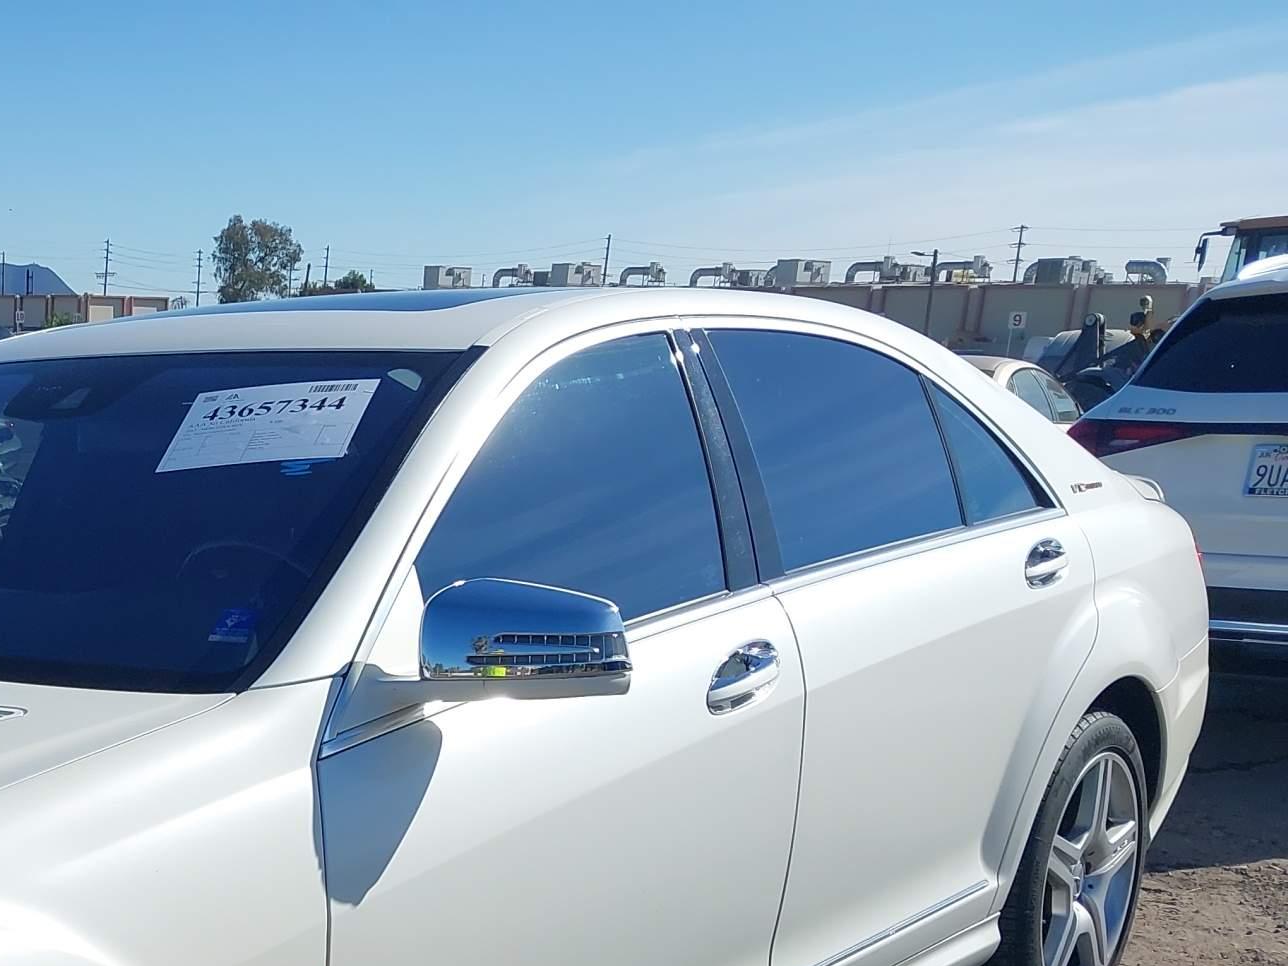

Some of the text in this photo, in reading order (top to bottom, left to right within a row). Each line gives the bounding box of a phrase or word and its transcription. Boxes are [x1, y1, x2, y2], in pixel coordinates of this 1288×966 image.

[1013, 314, 1022, 327] 9
[202, 396, 347, 421] 43657344
[1145, 407, 1177, 416] 300
